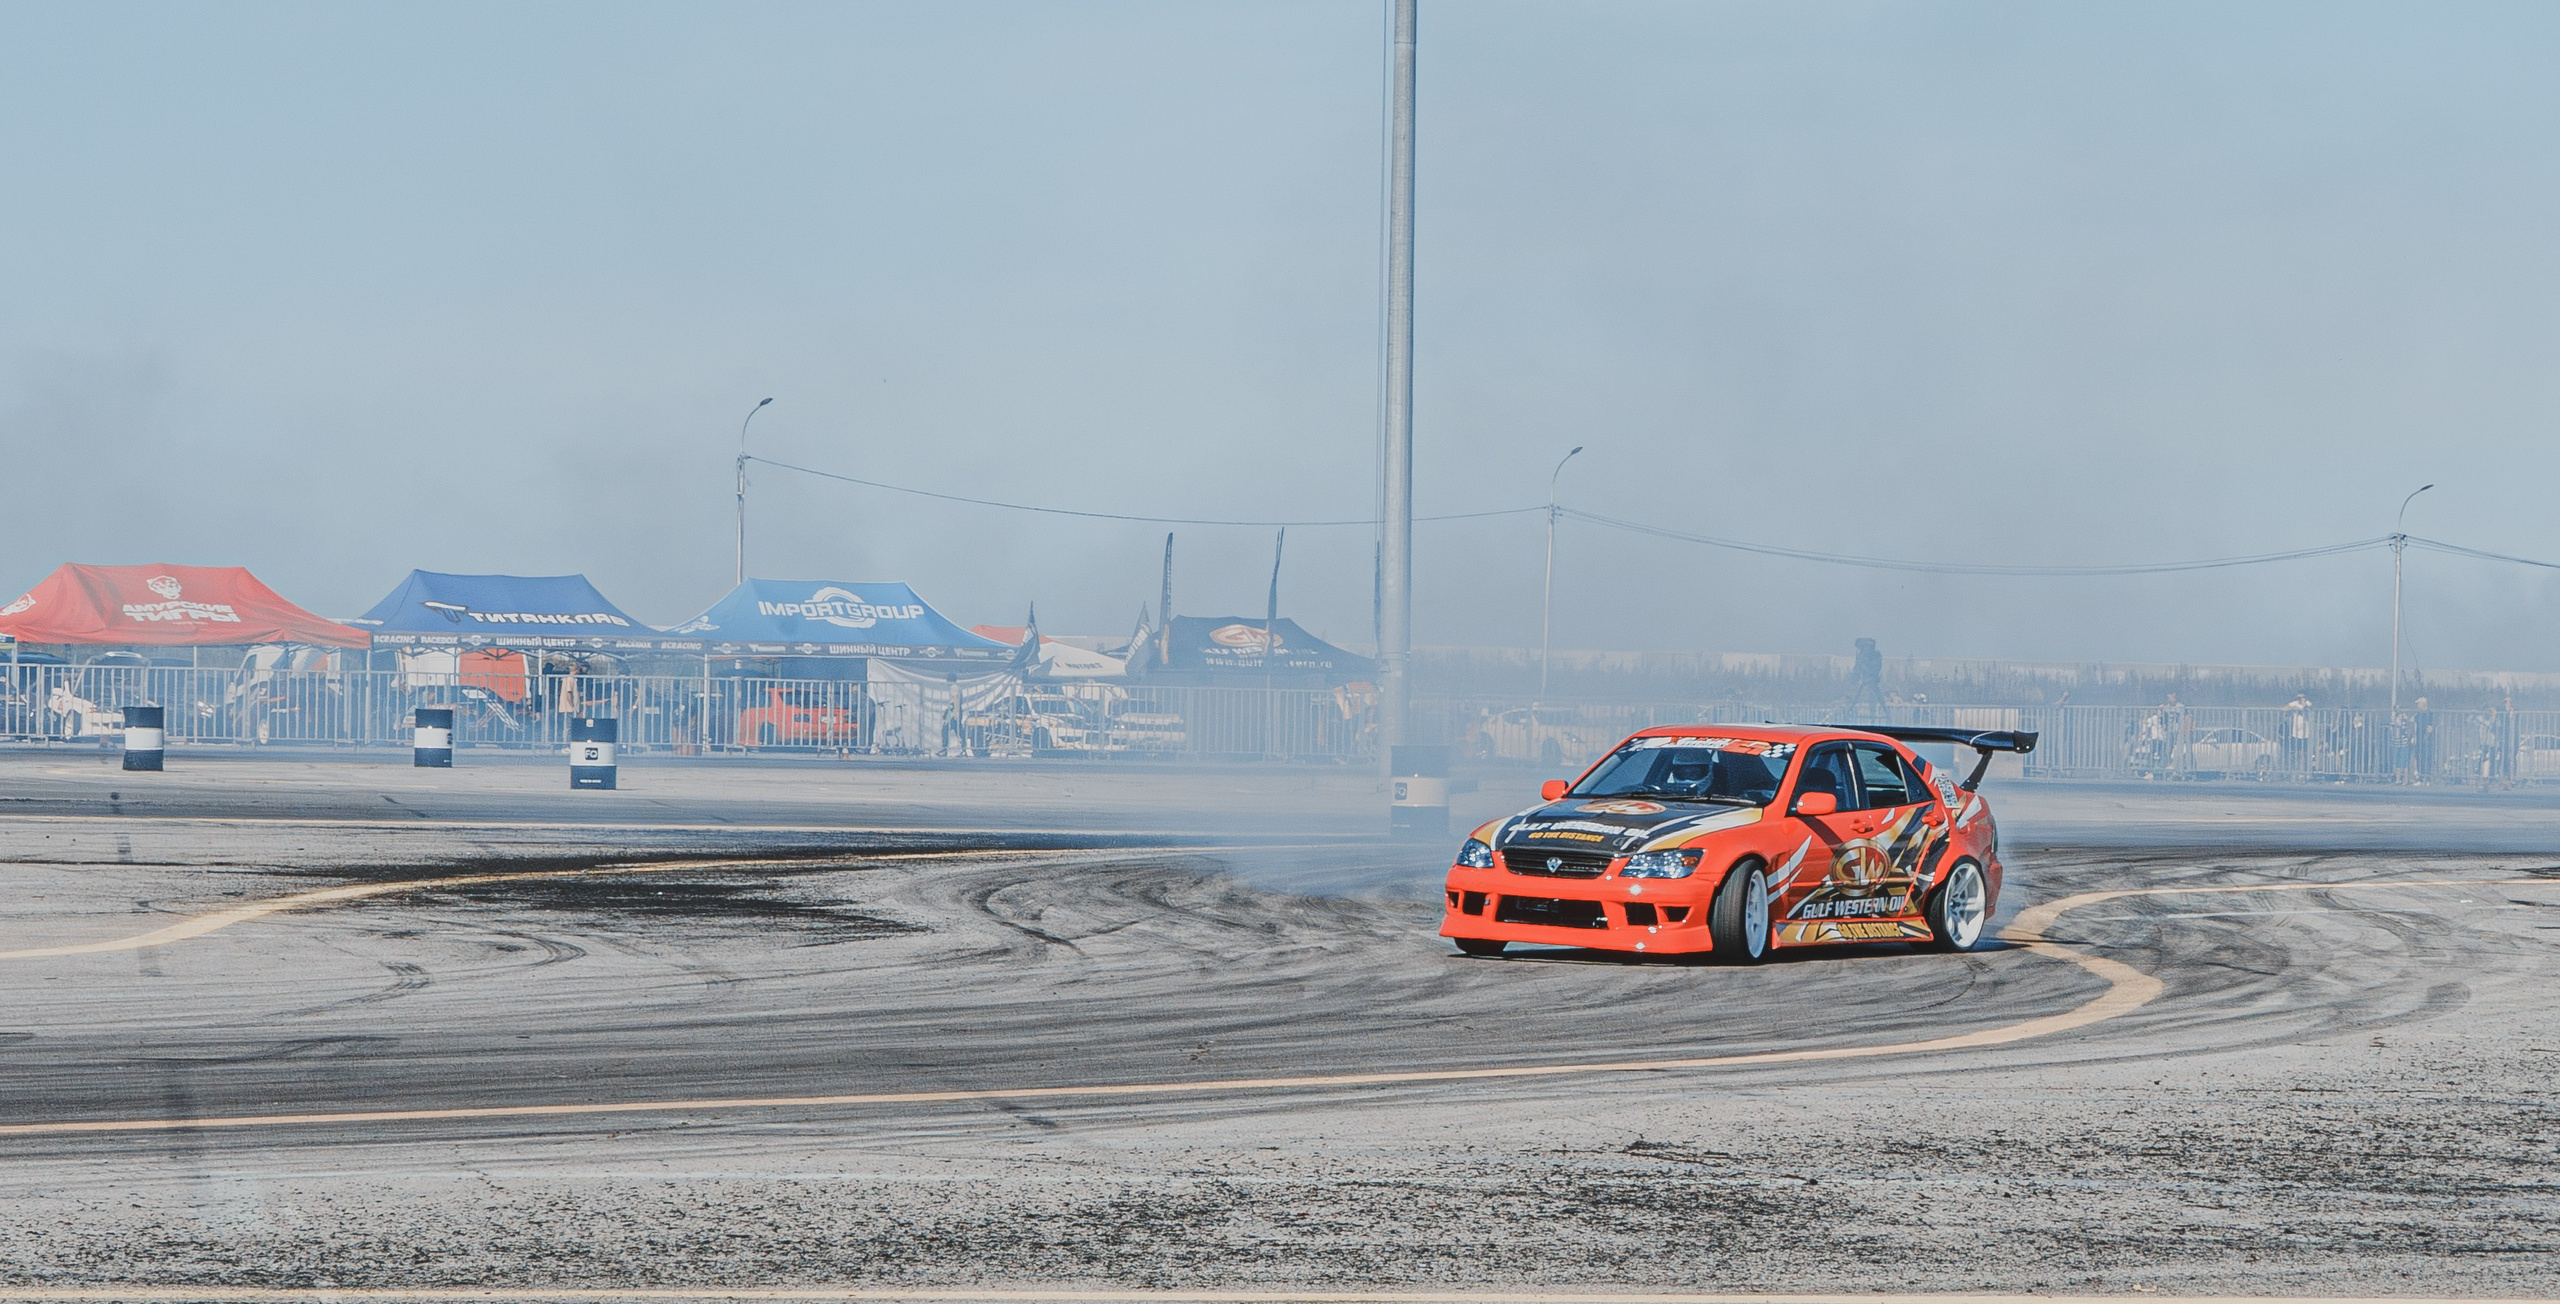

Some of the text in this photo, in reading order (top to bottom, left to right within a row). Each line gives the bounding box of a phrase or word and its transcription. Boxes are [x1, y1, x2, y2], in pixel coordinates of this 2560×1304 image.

[122, 601, 234, 613] АМУРСКИЕ
[758, 600, 925, 619] IMPORTGROUP
[125, 609, 241, 622] ТИГРЫ
[496, 636, 542, 646] ШИННЫЙ
[542, 638, 576, 647] ЦЕНТР
[829, 644, 876, 655] ШИННЫЙ
[877, 646, 911, 656] ЦЕНТР
[1558, 831, 1605, 843] DISTANCE
[1802, 901, 1834, 919] GULF
[1834, 896, 1889, 916] WESTERN
